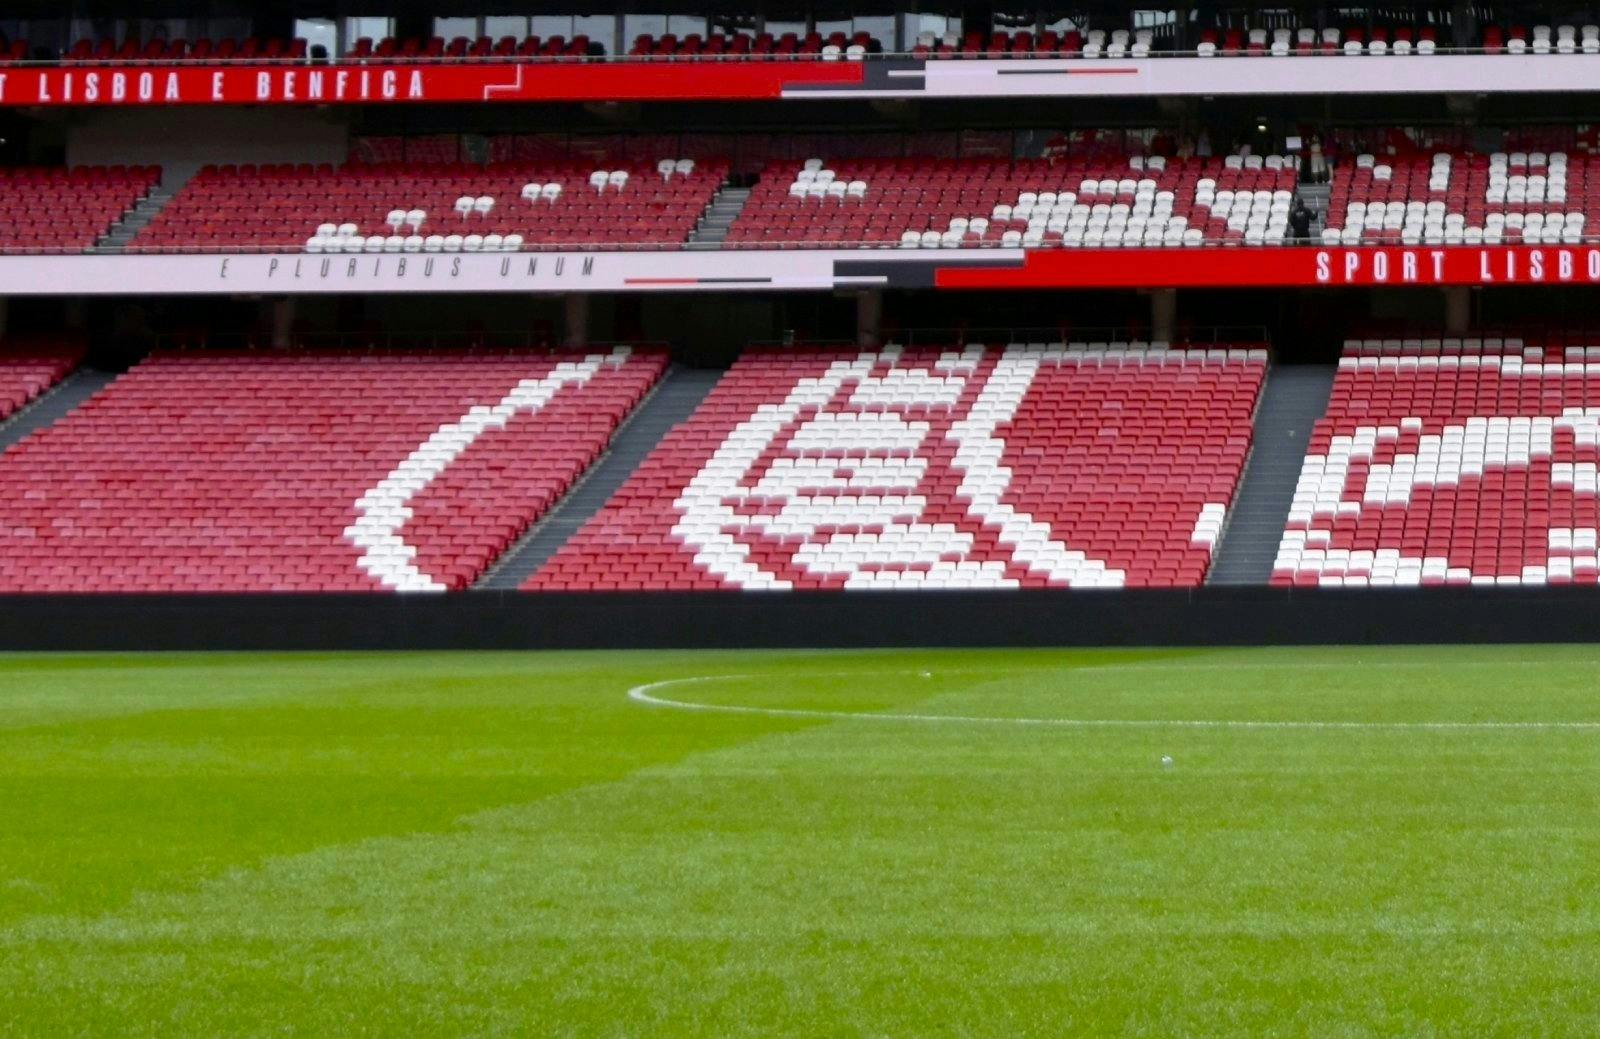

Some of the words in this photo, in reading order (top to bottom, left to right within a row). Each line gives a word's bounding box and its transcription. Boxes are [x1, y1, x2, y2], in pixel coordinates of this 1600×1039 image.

[38, 72, 180, 102] LISBOA
[211, 71, 225, 100] E
[256, 70, 424, 100] BENFICA
[220, 258, 231, 278] E
[268, 256, 462, 278] PLURIBUS
[500, 256, 595, 277] UNUM
[1315, 250, 1446, 283] SPORT
